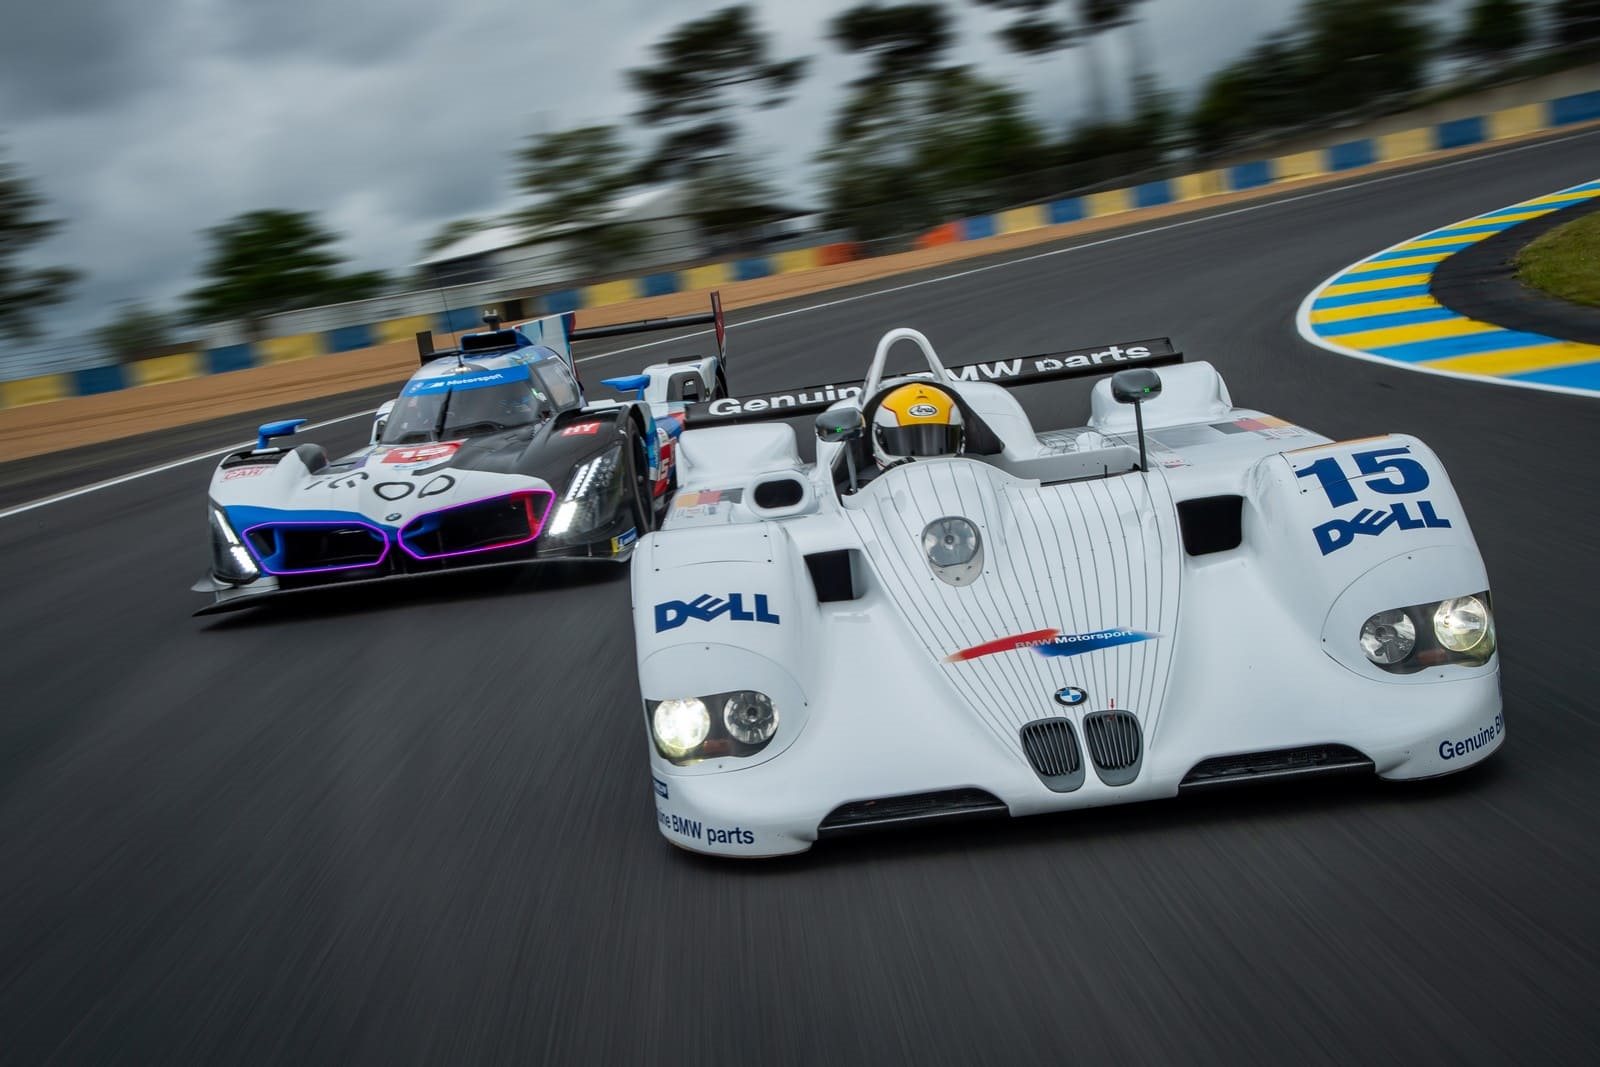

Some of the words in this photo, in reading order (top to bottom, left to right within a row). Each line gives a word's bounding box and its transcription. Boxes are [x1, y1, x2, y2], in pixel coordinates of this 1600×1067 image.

[446, 373, 503, 386] Motorsport
[708, 384, 862, 417] Genuin
[1034, 346, 1151, 373] parts
[1294, 447, 1430, 509] 15
[1312, 501, 1453, 556] DELL
[654, 593, 780, 633] DELL
[1014, 637, 1052, 649] BMW
[1053, 629, 1133, 645] Motorsport
[1438, 724, 1495, 760] Genuine
[671, 814, 702, 840] BMW
[706, 826, 755, 846] parts
